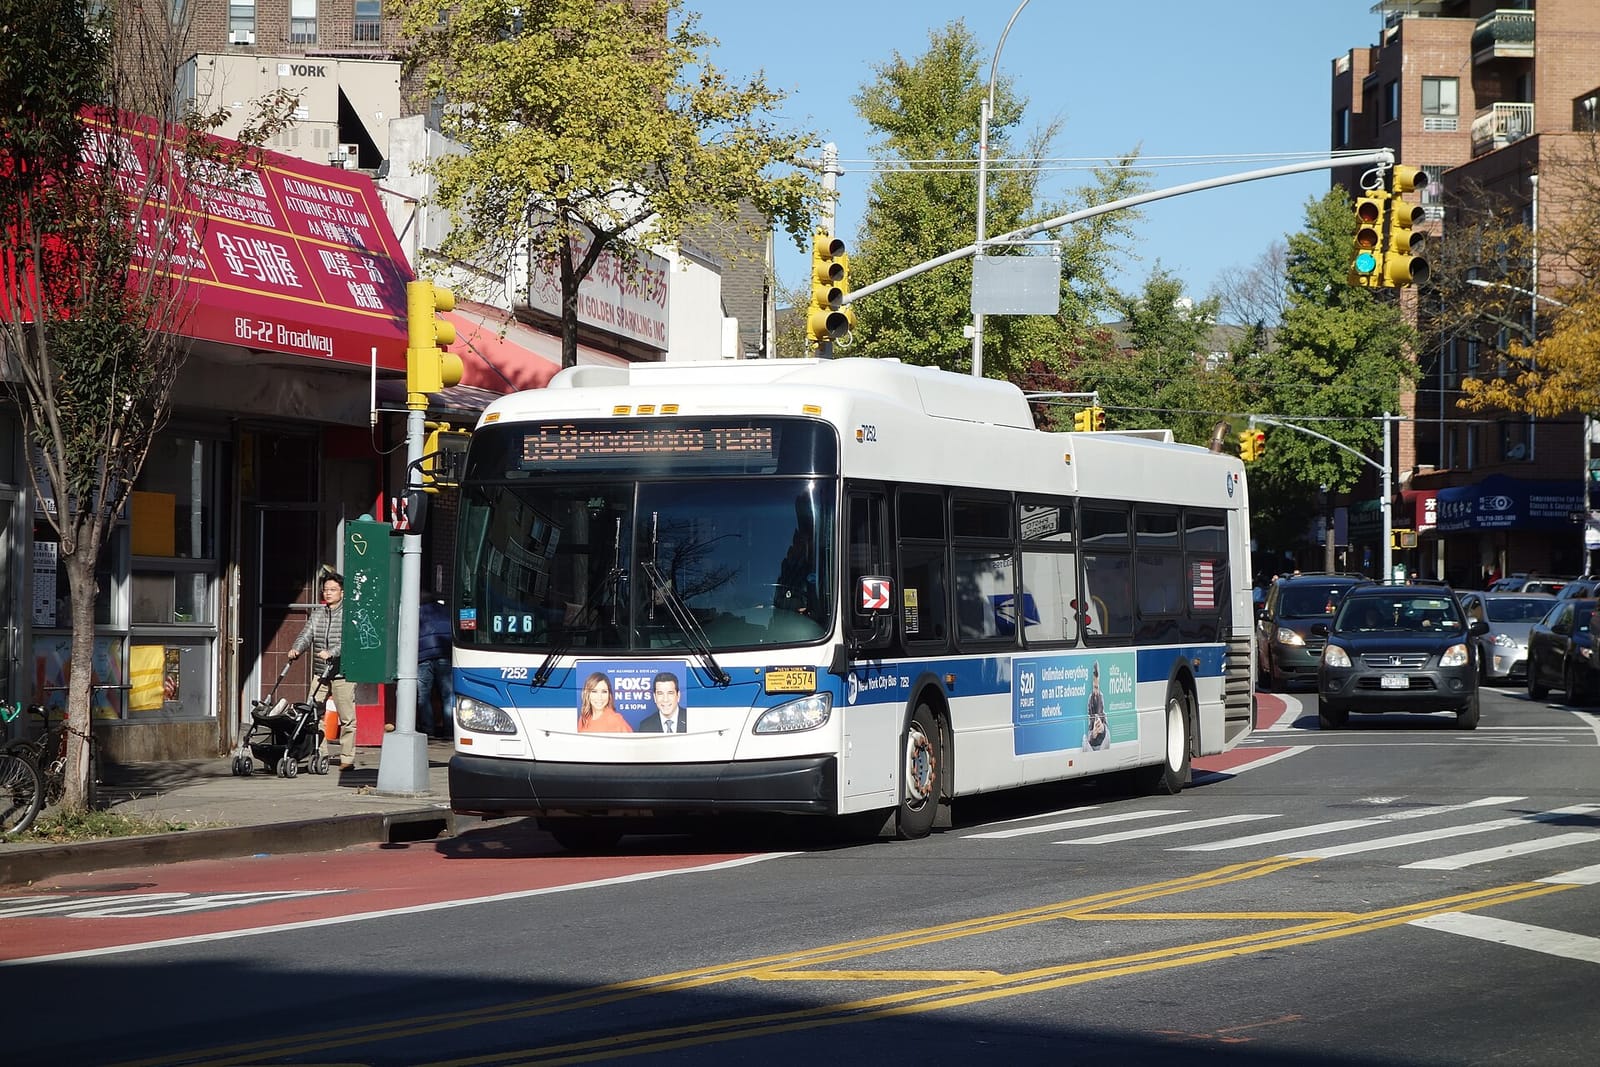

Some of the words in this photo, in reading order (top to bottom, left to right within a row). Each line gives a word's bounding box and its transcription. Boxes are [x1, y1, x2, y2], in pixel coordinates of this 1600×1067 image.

[290, 64, 326, 78] YORK
[283, 178, 322, 200] ALTMAN
[285, 196, 337, 220] ATTORNEYS
[335, 207, 350, 224] AT
[348, 209, 370, 228] LAW
[307, 219, 325, 237] AA
[586, 295, 615, 323] GOLDEN
[616, 306, 653, 339] SPARKLING
[653, 320, 666, 342] INC
[235, 317, 274, 343] 86-22
[277, 324, 334, 357] Broadway
[861, 424, 877, 442] 7252
[500, 667, 528, 679] 7252
[792, 673, 813, 686] 5574
[900, 676, 910, 688] 7252
[1041, 667, 1065, 681] Unlimited
[1064, 665, 1089, 682] everything
[858, 681, 869, 692] New
[868, 675, 879, 690] York
[878, 676, 889, 690] City
[888, 674, 897, 687] Bus
[1020, 671, 1035, 696] $20
[1041, 687, 1048, 699] on
[1048, 687, 1055, 698] an
[1055, 685, 1064, 699] LTE
[1063, 683, 1086, 698] advanced
[1109, 671, 1132, 695] mobile
[615, 692, 651, 700] NEWS
[1041, 703, 1063, 717] network.
